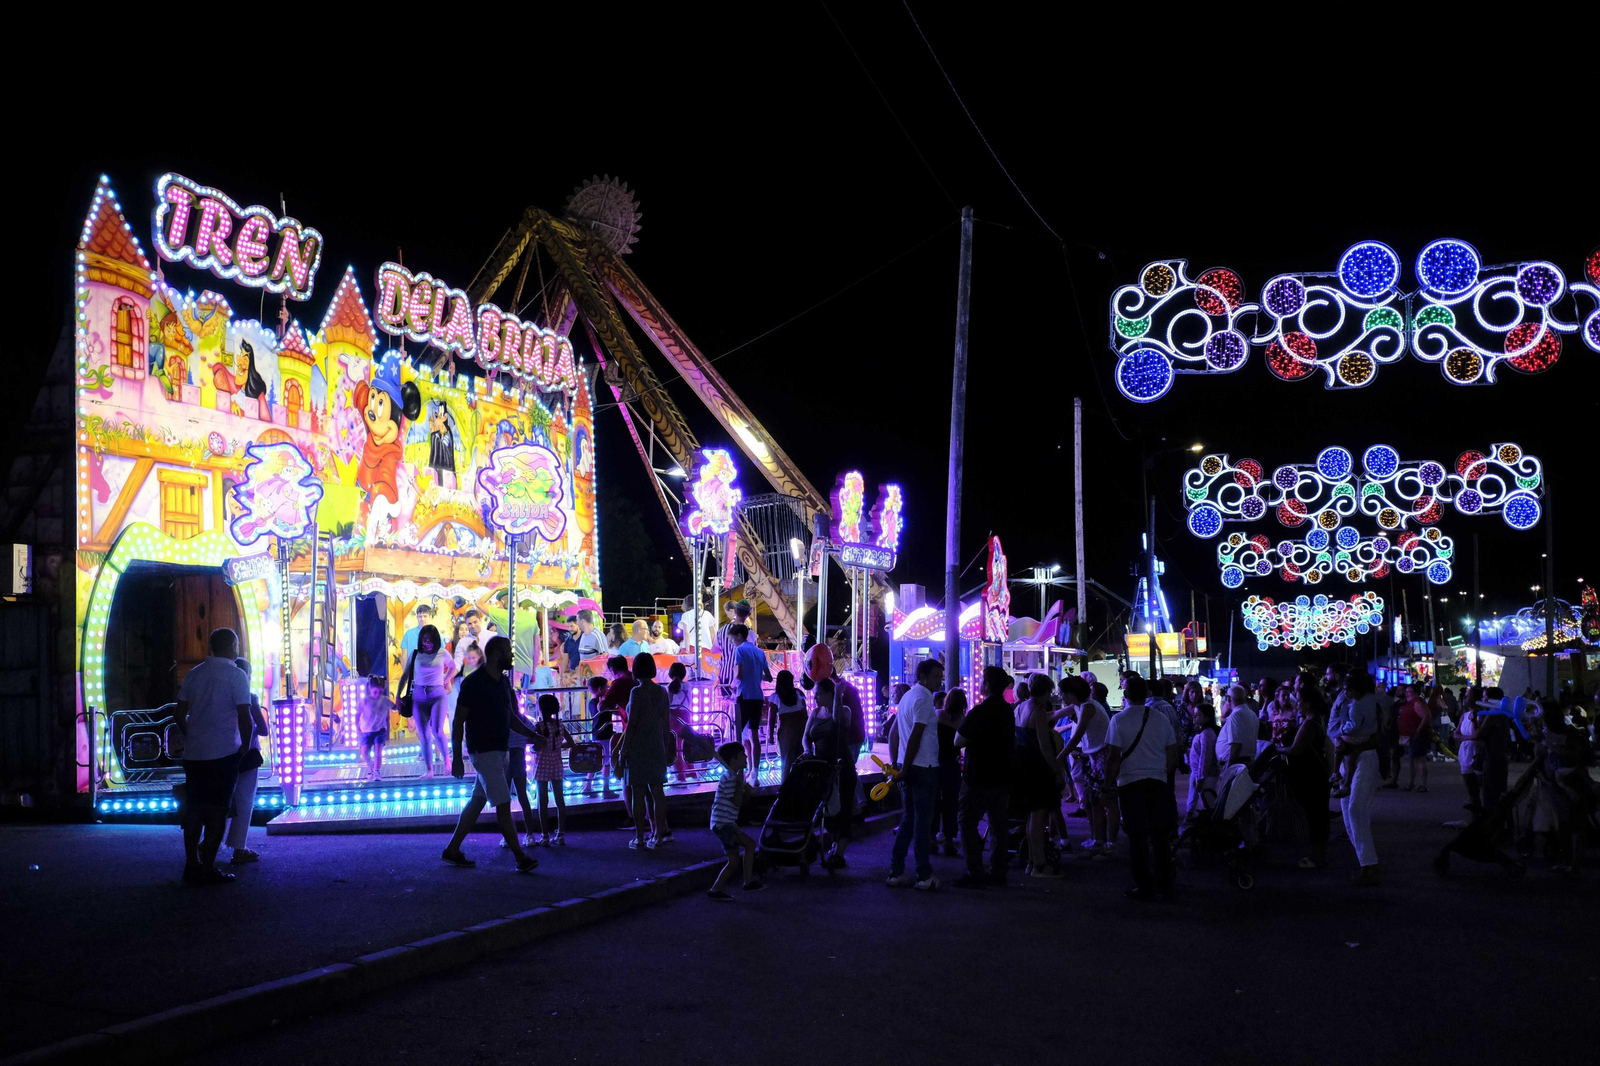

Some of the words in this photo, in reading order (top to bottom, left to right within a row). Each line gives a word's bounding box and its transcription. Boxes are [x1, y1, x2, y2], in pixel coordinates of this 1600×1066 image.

[480, 311, 577, 390] BRUJA
[500, 503, 550, 519] SALIDA
[232, 555, 270, 580] SALIDA
